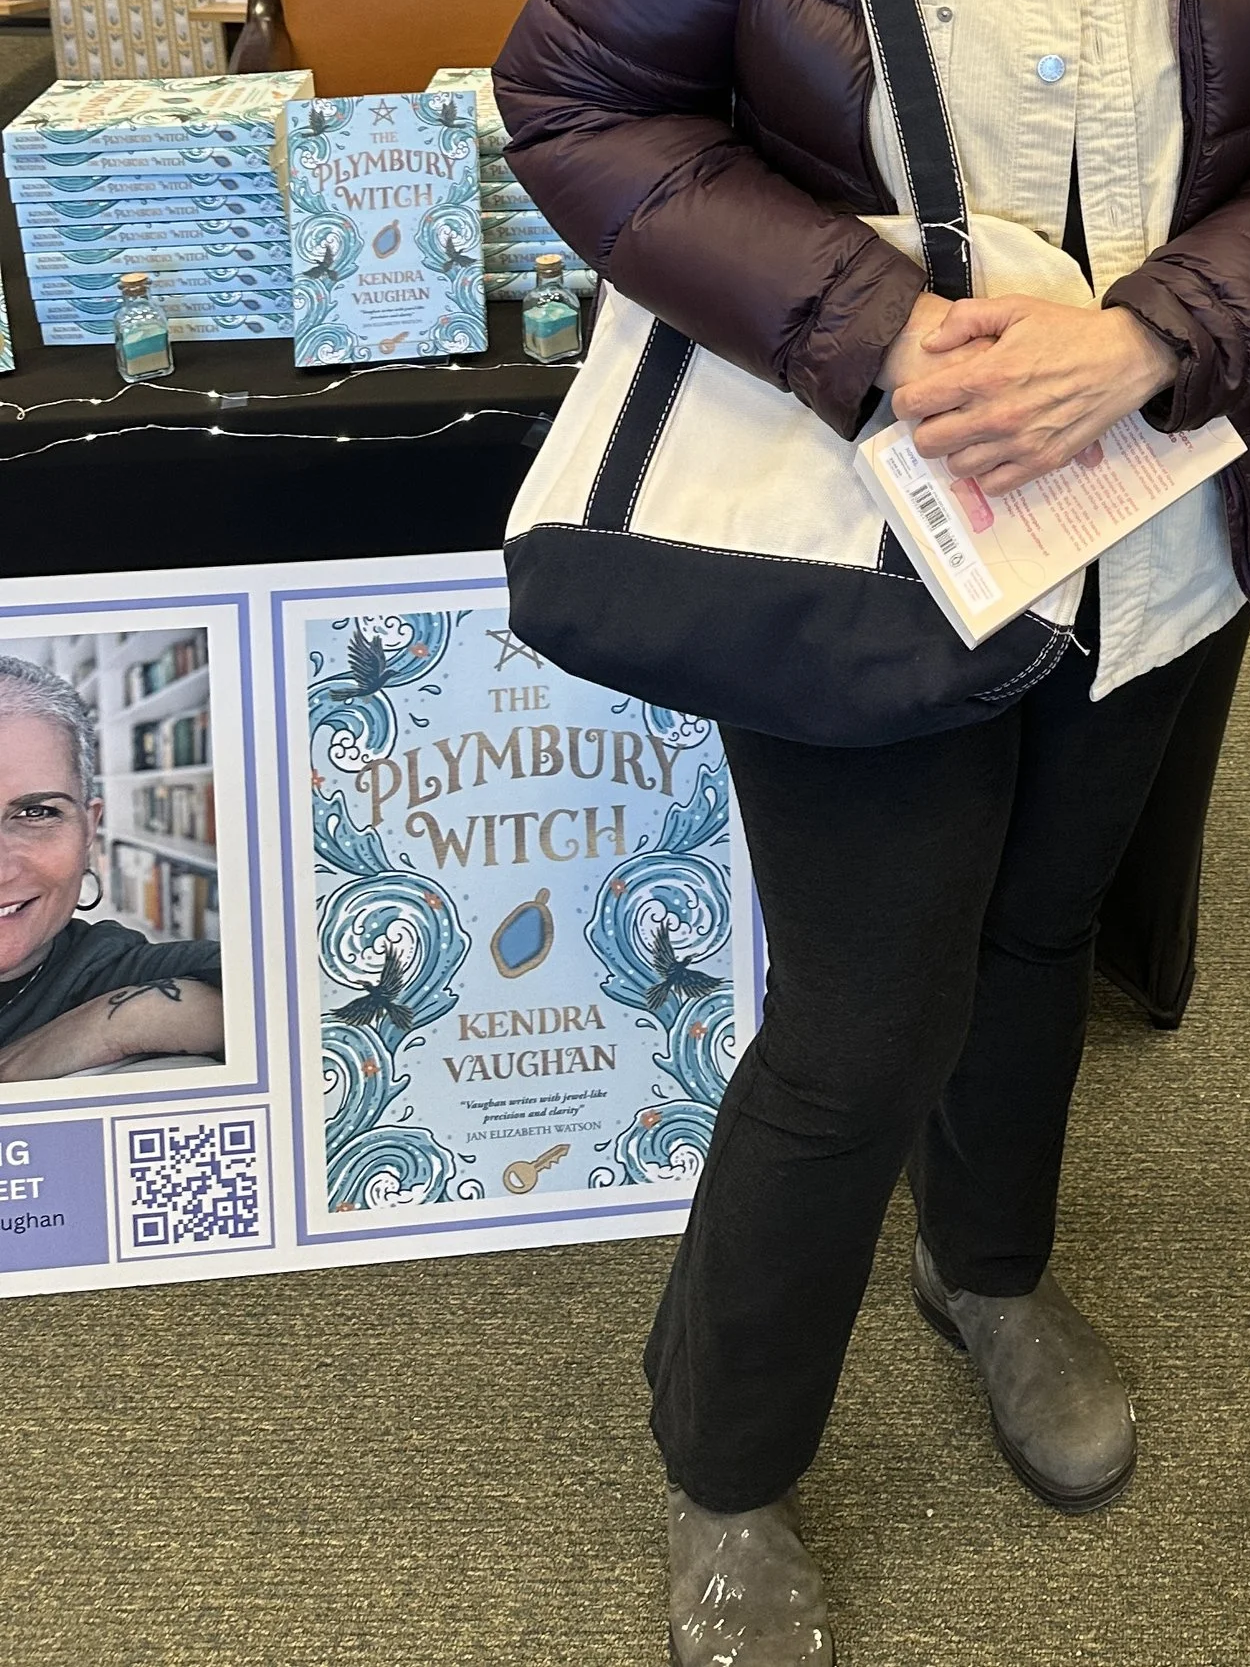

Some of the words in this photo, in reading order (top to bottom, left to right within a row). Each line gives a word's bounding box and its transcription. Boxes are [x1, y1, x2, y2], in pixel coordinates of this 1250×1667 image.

[156, 132, 190, 143] WITCH
[370, 131, 398, 144] THE
[152, 156, 186, 167] WITCH
[312, 148, 457, 192] PLYMBURY
[159, 180, 194, 191] WITCH
[334, 183, 433, 211] WITCH
[165, 205, 200, 216] WITCH
[170, 229, 204, 240] WITCH
[498, 226, 552, 239] PLYMBUR
[175, 251, 209, 263] WITCH
[178, 276, 212, 286] WITCH
[358, 270, 425, 286] KENDRA
[352, 287, 430, 305] VAUGHAN
[184, 302, 216, 312] WITCH
[187, 323, 220, 333] WITCH
[904, 447, 920, 467] NOVEL
[487, 685, 551, 715] THE
[354, 726, 685, 827] PLYMBURY
[405, 804, 628, 871] WITCH
[457, 1005, 607, 1042] KENDRA
[442, 1043, 618, 1084] VAUGHAN
[460, 1098, 506, 1111] “Vaughan
[508, 1097, 537, 1106] writes
[539, 1093, 561, 1103] with
[562, 1089, 608, 1103] jewel-like
[483, 1110, 526, 1124] precision
[528, 1108, 547, 1118] and
[548, 1104, 585, 1118] clarity”
[465, 1131, 487, 1143] JAN
[490, 1125, 551, 1140] ELIZABETH
[553, 1120, 602, 1134] WATSON
[0, 1212, 65, 1234] ughan
